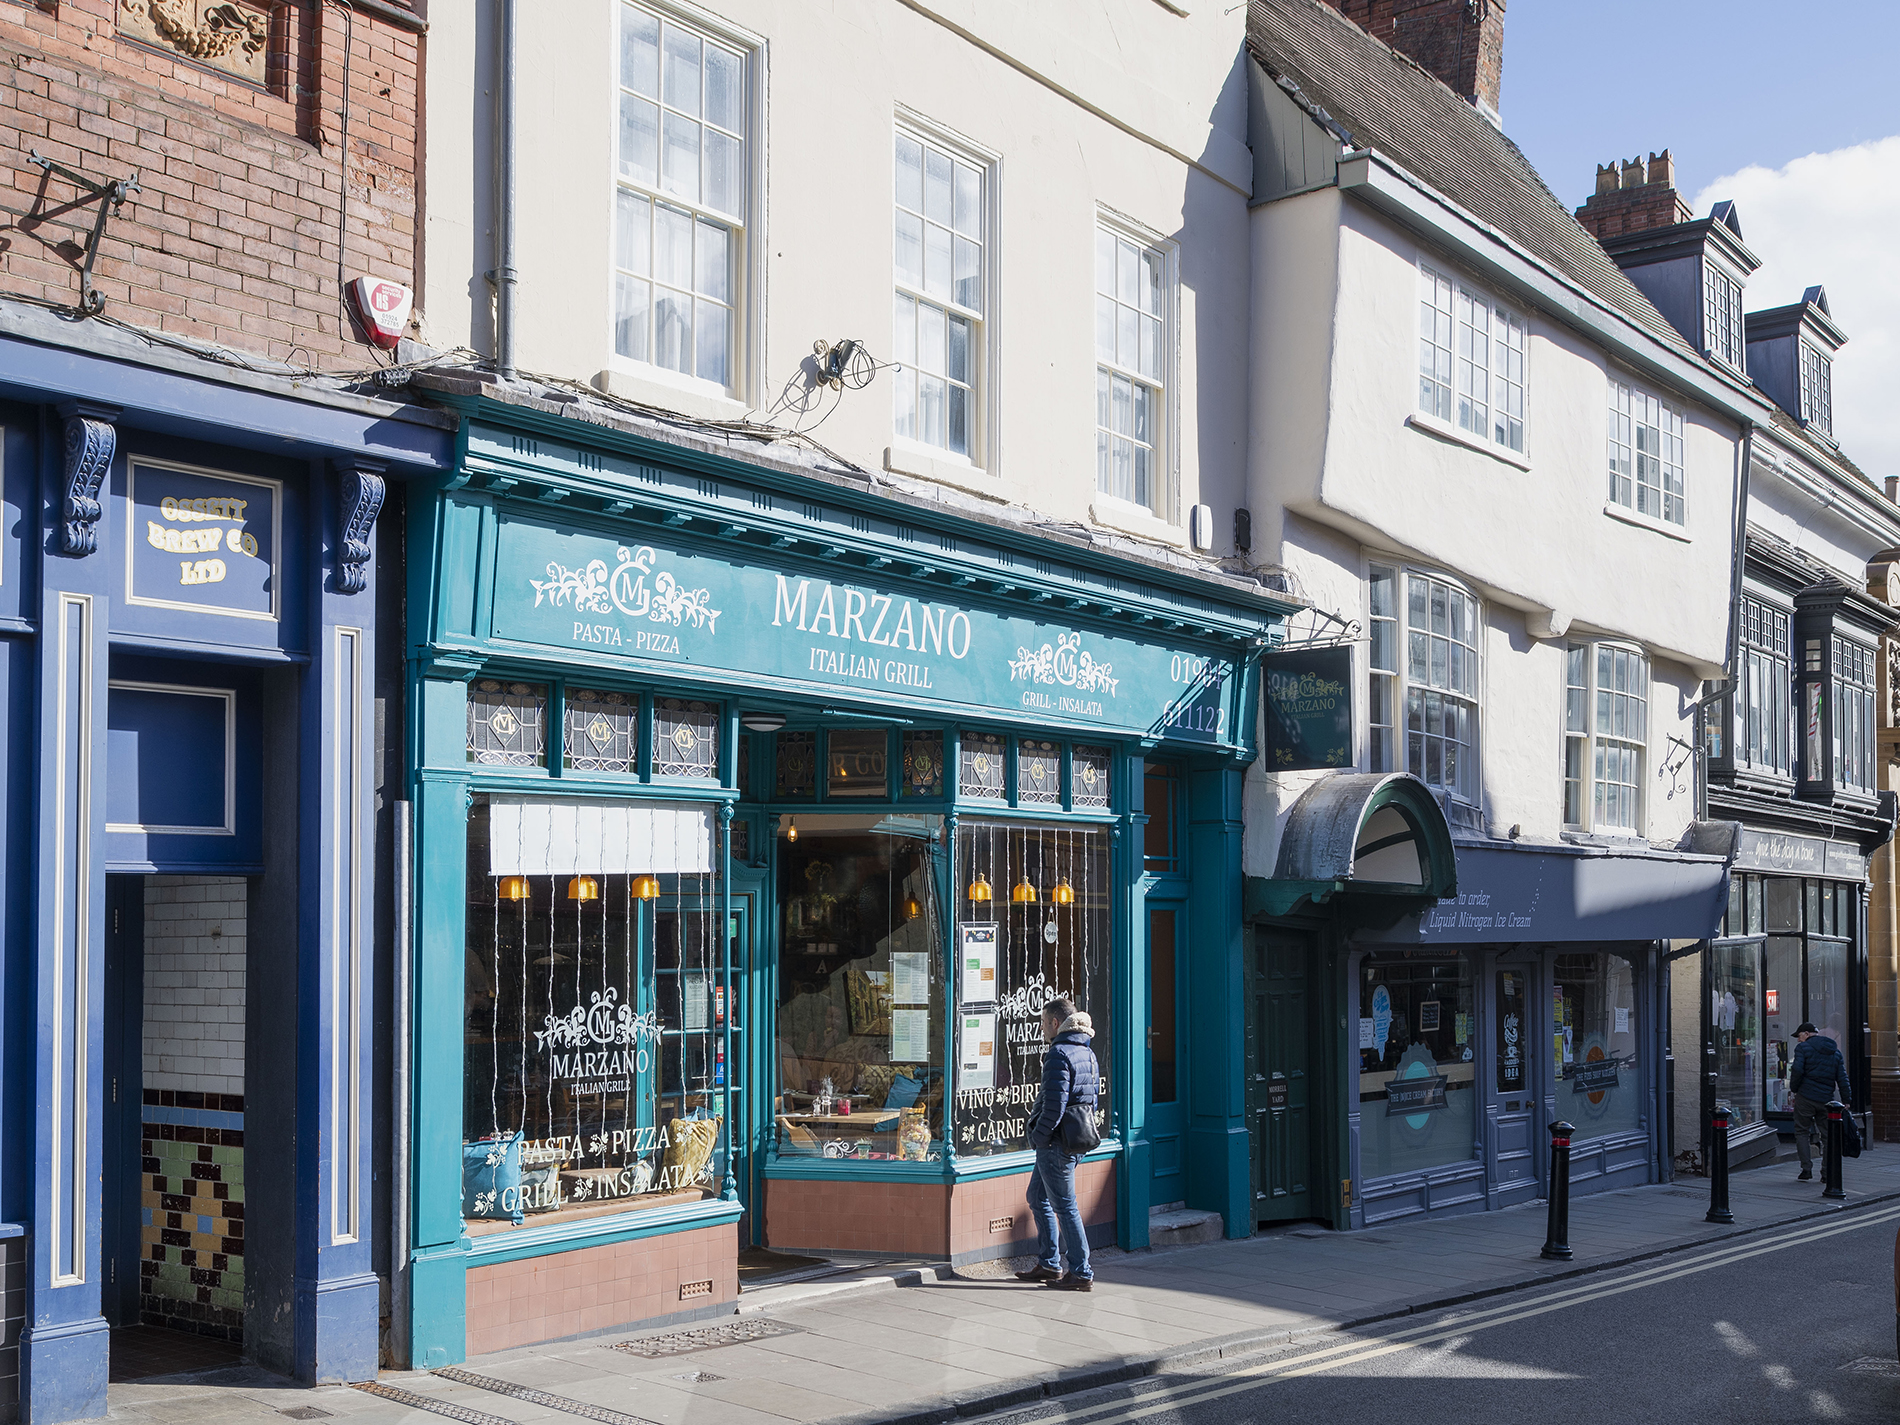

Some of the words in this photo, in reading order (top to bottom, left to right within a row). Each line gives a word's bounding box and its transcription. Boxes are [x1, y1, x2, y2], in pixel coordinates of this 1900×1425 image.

[376, 292, 389, 311] HS
[160, 496, 248, 523] OSSETT
[147, 520, 223, 554] BREW
[226, 528, 259, 557] CO
[180, 558, 227, 585] LTD
[771, 573, 971, 660] MARZANO
[572, 621, 623, 647] PASTA
[636, 630, 681, 655] PIZZA
[808, 647, 881, 681] ITALIAN
[884, 660, 933, 689] GRILL
[1022, 690, 1051, 709] GRILL
[1058, 696, 1103, 717] INSALATA
[1163, 699, 1225, 735] 611122
[1281, 697, 1336, 714] MARZANO
[1754, 836, 1769, 866] give
[1770, 837, 1781, 858] the
[1780, 837, 1795, 869] dog
[1795, 846, 1800, 860] a
[1800, 840, 1815, 861] bone
[1458, 891, 1467, 905] to
[1429, 911, 1457, 932] Liquid
[1458, 911, 1493, 932] Nitrogen
[1495, 912, 1507, 928] Ice
[1507, 912, 1532, 928] Cream
[1006, 1021, 1045, 1043] MARZ
[1016, 1045, 1038, 1056] ITALIAN
[552, 1049, 649, 1080] MARZANO
[1504, 1067, 1519, 1078] IDEA
[570, 1081, 605, 1096] ITALIAN
[606, 1080, 631, 1093] GRILL
[959, 1088, 995, 1110] VINO
[1271, 1095, 1285, 1104] YARD
[977, 1118, 1025, 1143] CARNE
[517, 1134, 585, 1166] PASTA
[611, 1125, 671, 1155] PIZZA
[501, 1179, 569, 1212] GRILL
[596, 1163, 696, 1200] INSALATA
